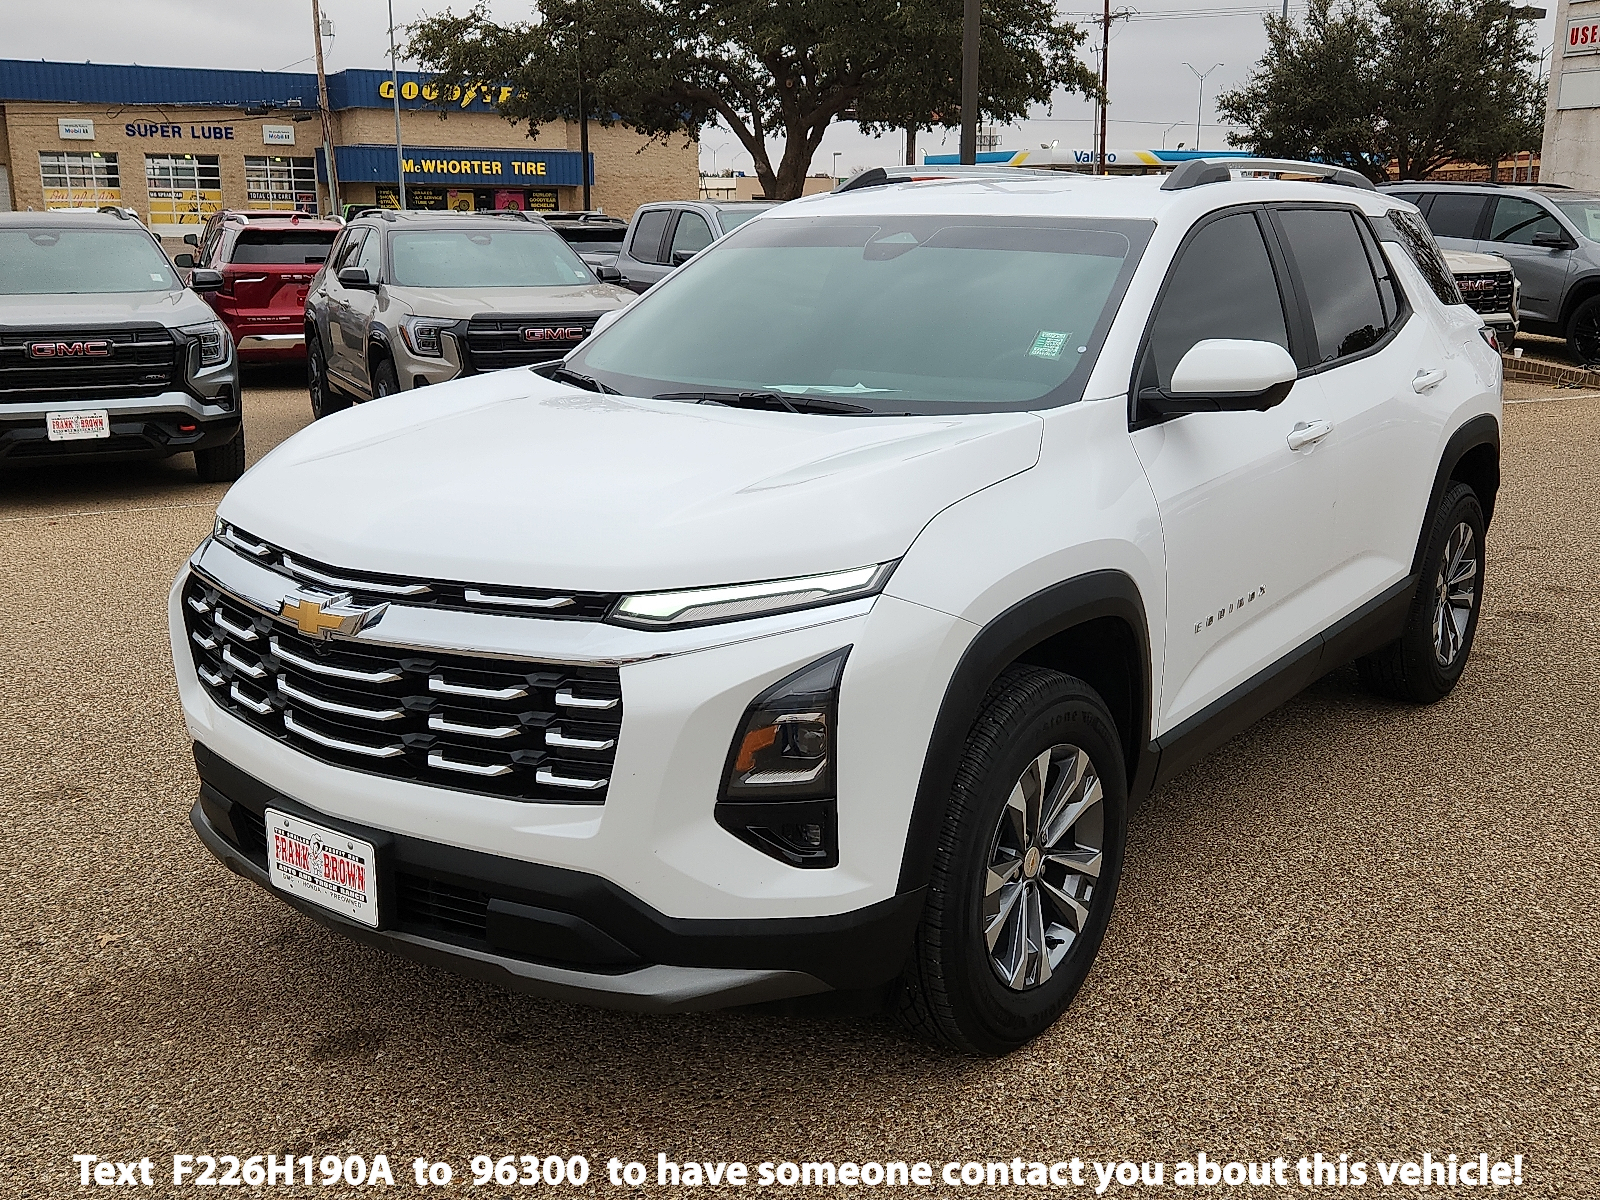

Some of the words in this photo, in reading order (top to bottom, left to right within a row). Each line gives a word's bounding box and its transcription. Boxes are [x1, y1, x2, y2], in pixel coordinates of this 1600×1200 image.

[1570, 25, 1600, 46] USE
[125, 123, 182, 138] SUPER
[191, 126, 234, 139] LUBE
[402, 159, 502, 175] McWHORTER
[511, 161, 547, 175] TIRE
[1457, 279, 1495, 291] GMC
[525, 327, 584, 341] GMC
[31, 341, 108, 357] GMC
[52, 420, 74, 430] FRANK
[80, 419, 103, 428] BROWN
[274, 835, 310, 871] FRANK
[323, 853, 366, 893] BROWN
[278, 864, 297, 877] AUTO
[299, 871, 313, 882] AND
[314, 877, 339, 892] TRUCK
[340, 886, 366, 902] RANCH
[302, 880, 323, 894] HONDA
